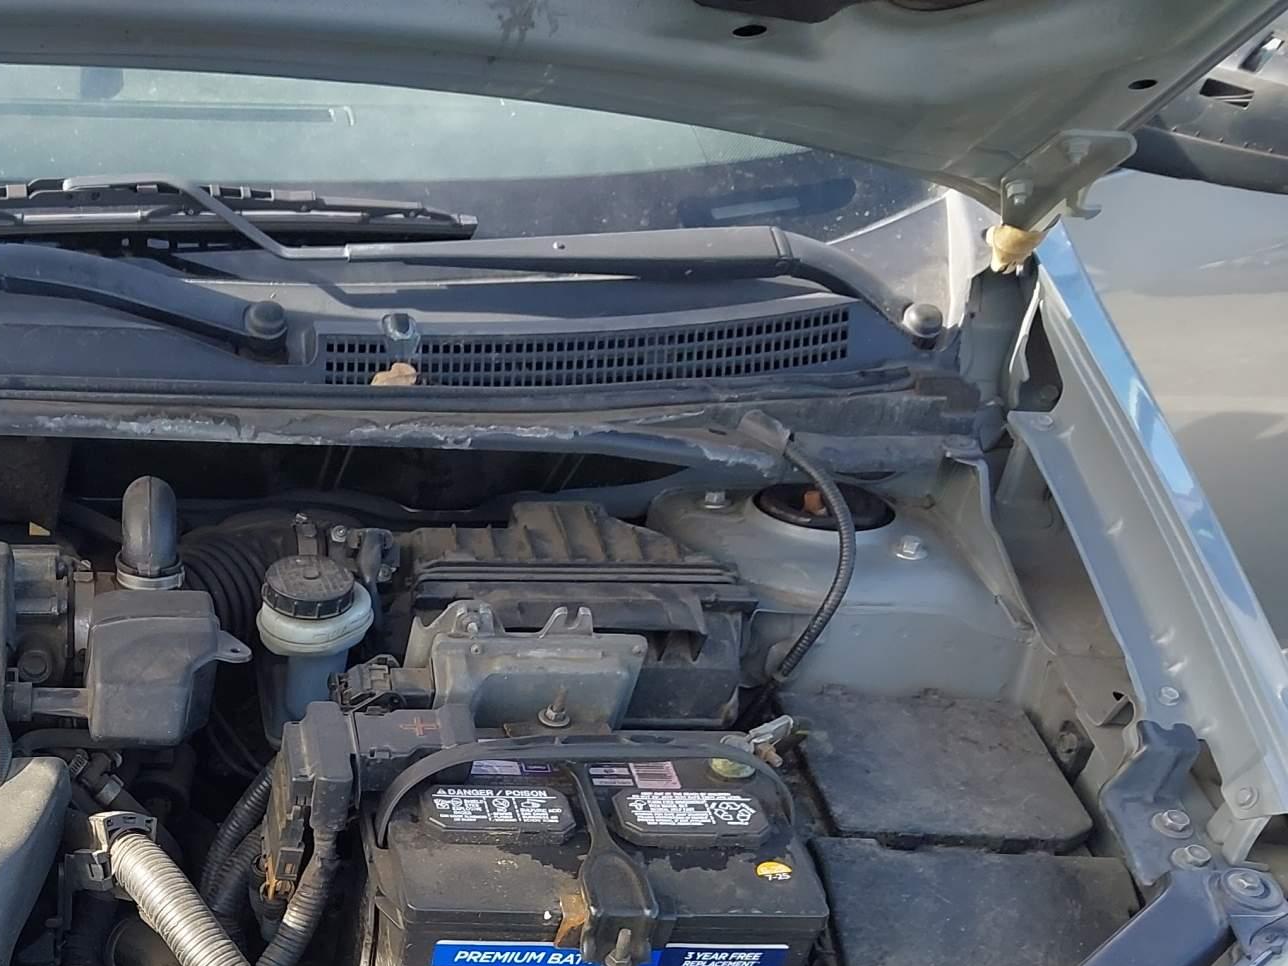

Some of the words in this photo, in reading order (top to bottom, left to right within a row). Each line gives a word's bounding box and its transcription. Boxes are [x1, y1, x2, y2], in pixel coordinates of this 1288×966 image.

[447, 788, 493, 797] DANGER
[505, 789, 547, 797] POISON
[454, 951, 545, 964] PREMIUM
[684, 952, 695, 960] 3
[695, 952, 729, 960] YEAR
[728, 953, 763, 961] FREE
